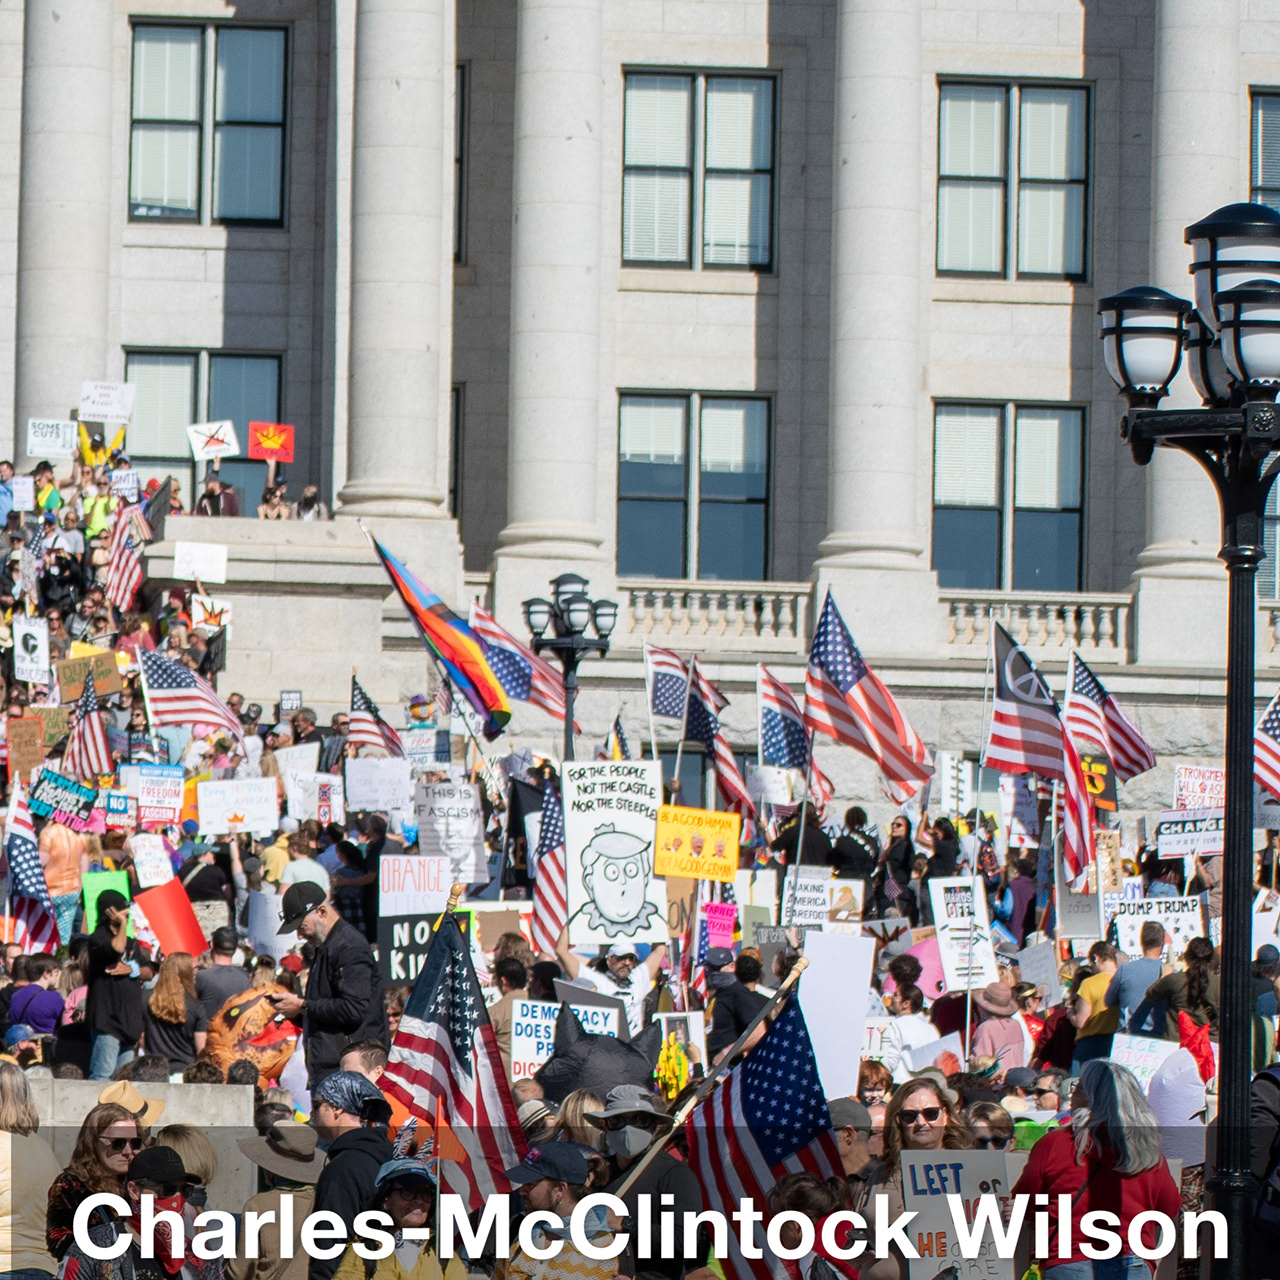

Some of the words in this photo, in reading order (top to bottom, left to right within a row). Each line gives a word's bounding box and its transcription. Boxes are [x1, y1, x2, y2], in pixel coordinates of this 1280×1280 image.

[31, 422, 61, 430] SOME
[33, 431, 61, 439] CUTS
[568, 769, 589, 783] FOR
[590, 767, 607, 778] THE
[609, 766, 647, 781] PEOPLE
[142, 787, 181, 799] FREEDOM
[422, 786, 456, 799] THIS
[460, 788, 473, 799] IS
[577, 783, 598, 796] NOT
[600, 781, 618, 793] THE
[620, 782, 657, 799] CASTLE
[109, 798, 126, 810] NO
[414, 805, 481, 818] FASCISM
[597, 799, 615, 811] THE
[615, 799, 658, 820] STEEPLE
[680, 814, 704, 827] GOOD
[381, 858, 445, 893] ORANGE
[787, 880, 823, 894] MAKING
[787, 894, 826, 908] AMERICA
[1119, 902, 1153, 916] DUMP
[1155, 899, 1198, 914] TRUMP
[785, 905, 828, 920] BAREFOOT
[392, 920, 431, 948] NO
[514, 1023, 552, 1044] DOES
[908, 1163, 963, 1197] LEFT
[918, 1232, 947, 1258] HE
